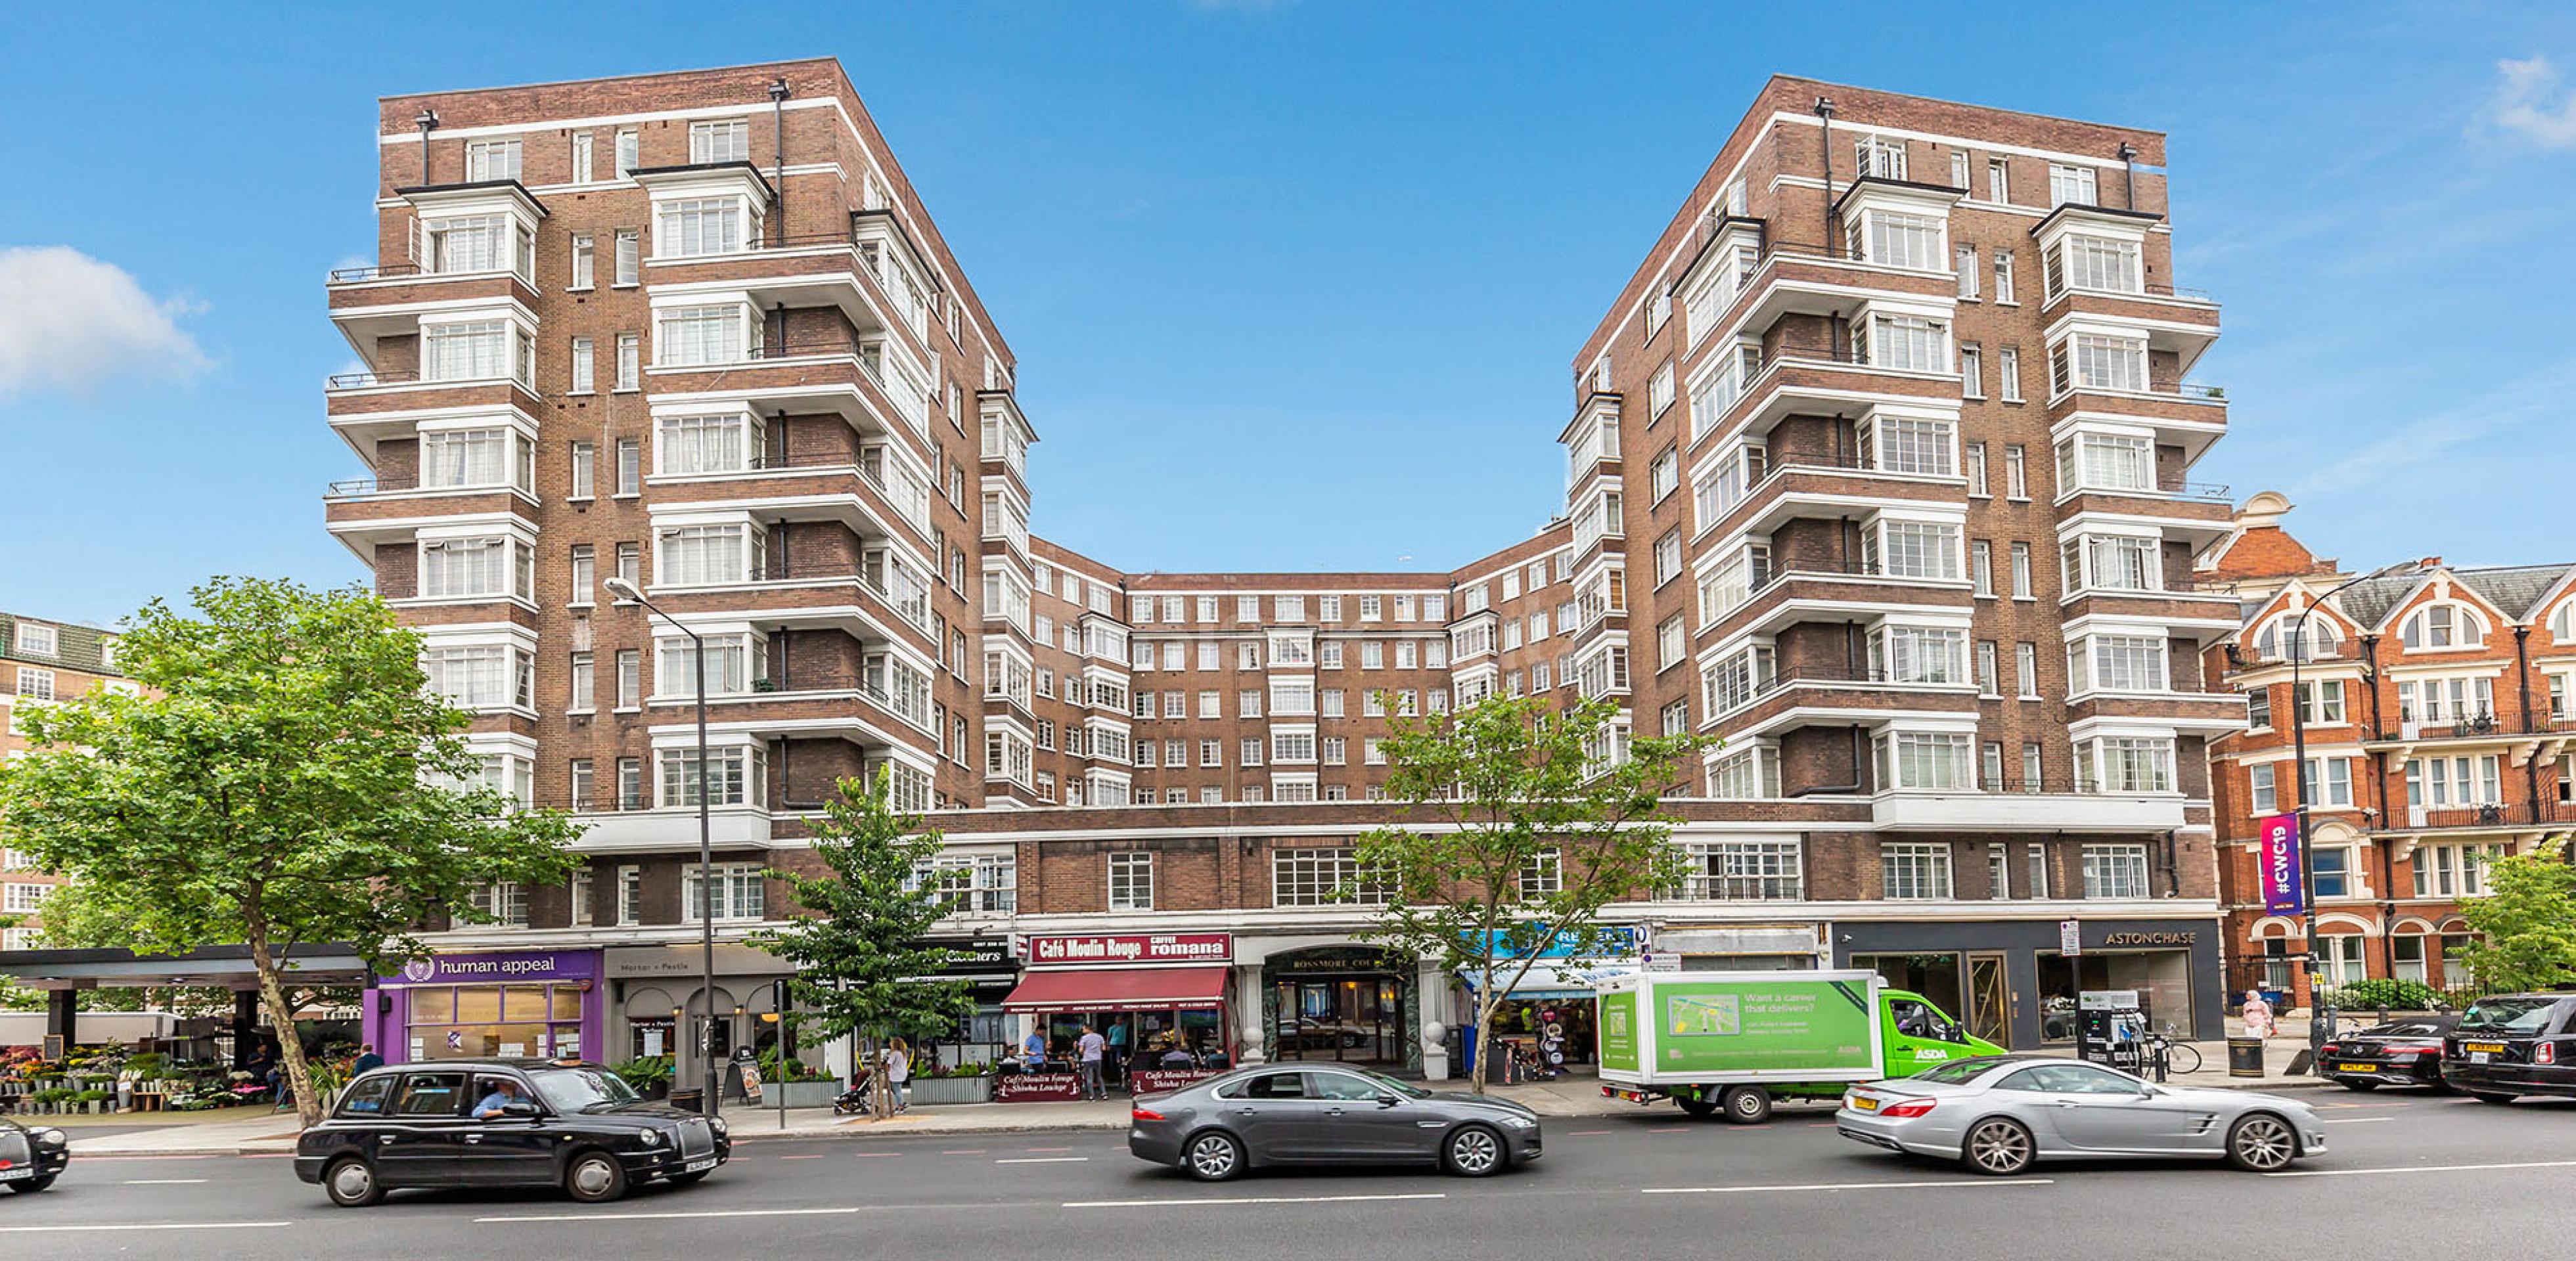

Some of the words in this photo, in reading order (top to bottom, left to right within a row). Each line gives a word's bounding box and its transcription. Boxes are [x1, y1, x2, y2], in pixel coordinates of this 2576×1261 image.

[2272, 826, 2291, 895] #CWC19
[2106, 932, 2197, 944] ASTONCHASE
[1039, 939, 1064, 958] Café
[1066, 939, 1105, 957] Moulin
[1107, 938, 1141, 960] Rouge
[1150, 943, 1223, 955] romana
[946, 950, 1001, 962] Cners
[441, 960, 497, 973] human
[501, 957, 555, 974] appeal
[1915, 1049, 1949, 1059] ASDA
